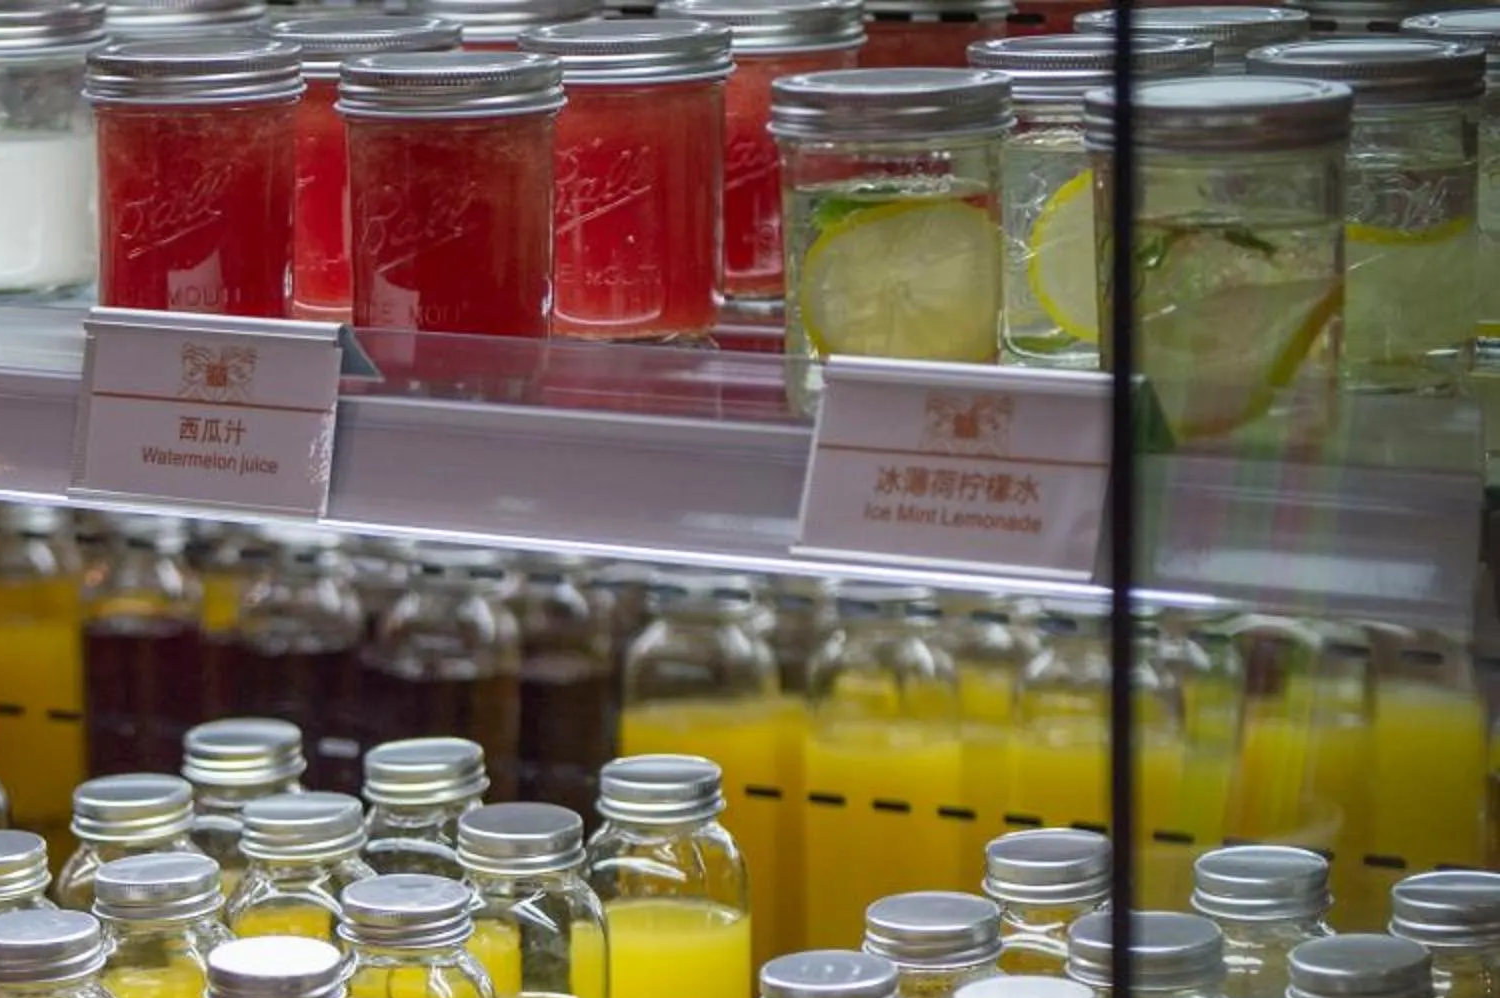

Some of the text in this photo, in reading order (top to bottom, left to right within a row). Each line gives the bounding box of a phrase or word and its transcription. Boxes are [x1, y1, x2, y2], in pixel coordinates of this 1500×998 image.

[179, 416, 247, 445] 西瓜汁
[141, 446, 279, 476] Watermelon juice
[864, 502, 1042, 534] Ice Mint Lemonade
